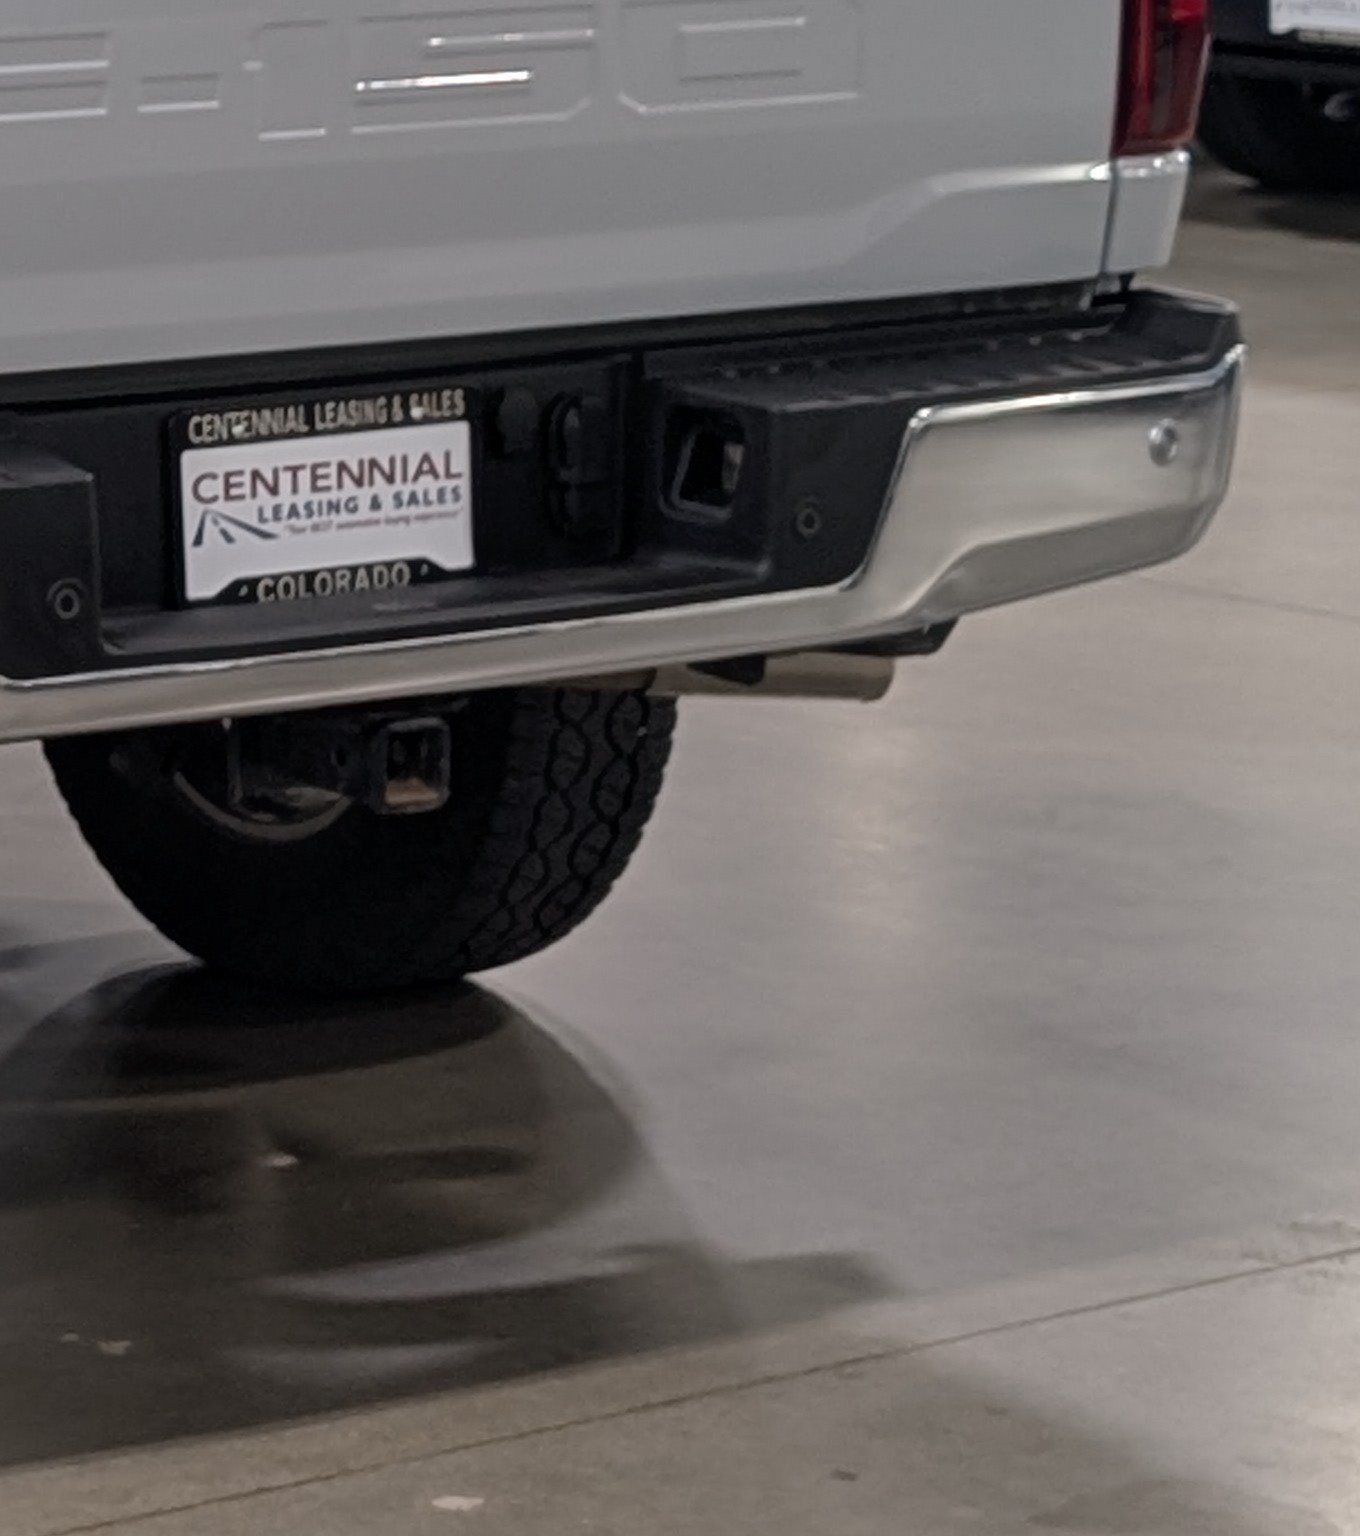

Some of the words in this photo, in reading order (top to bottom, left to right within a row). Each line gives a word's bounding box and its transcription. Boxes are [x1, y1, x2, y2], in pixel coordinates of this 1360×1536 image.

[188, 403, 309, 445] CENTENNIAL
[314, 393, 388, 431] LEASING
[392, 393, 404, 423] &
[408, 387, 466, 420] SALES
[192, 449, 463, 505] CENTENNIAL
[257, 496, 360, 525] LEASING
[369, 492, 382, 512] &
[392, 485, 463, 510] SALES
[256, 561, 411, 603] COLORADO
